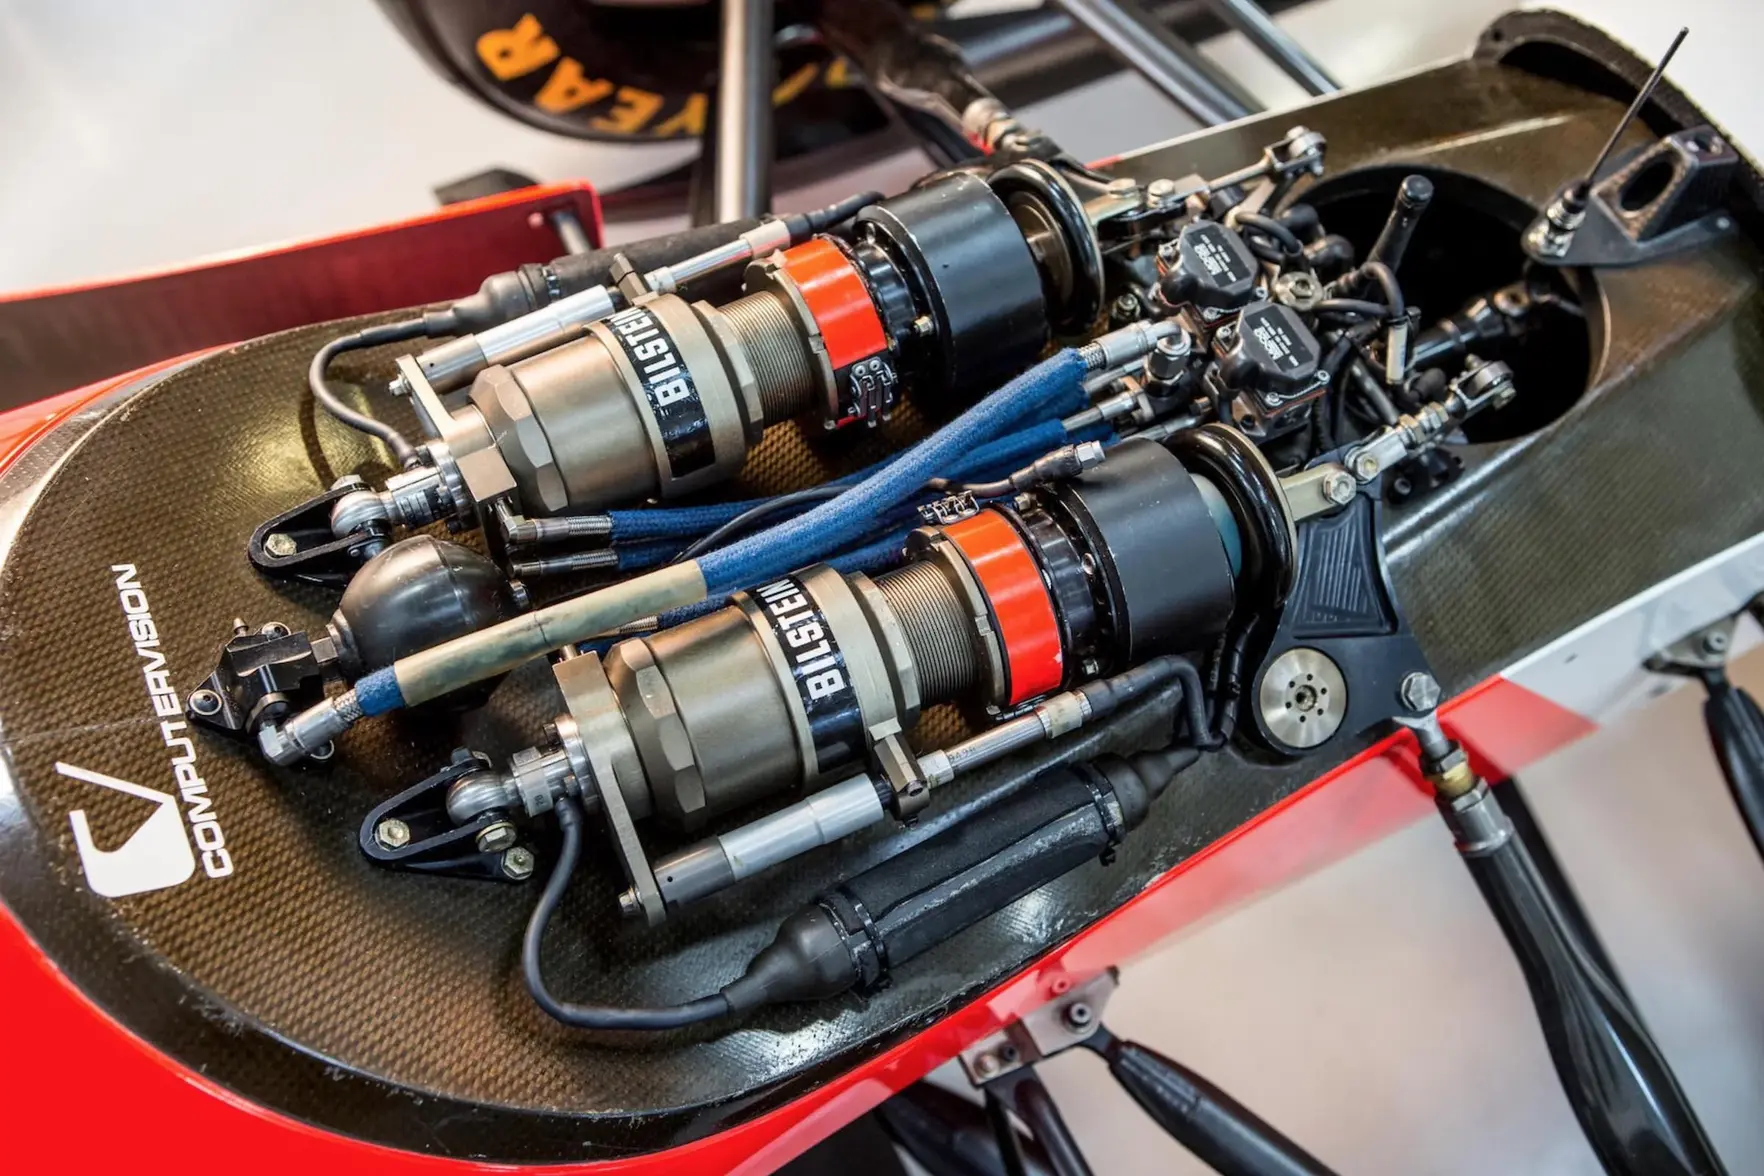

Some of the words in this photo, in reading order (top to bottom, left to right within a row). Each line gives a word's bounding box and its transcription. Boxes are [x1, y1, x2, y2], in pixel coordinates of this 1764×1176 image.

[604, 306, 690, 407] BILSTEIN
[755, 578, 846, 701] BILSTEIN
[111, 563, 235, 879] COMPUTERVISION
